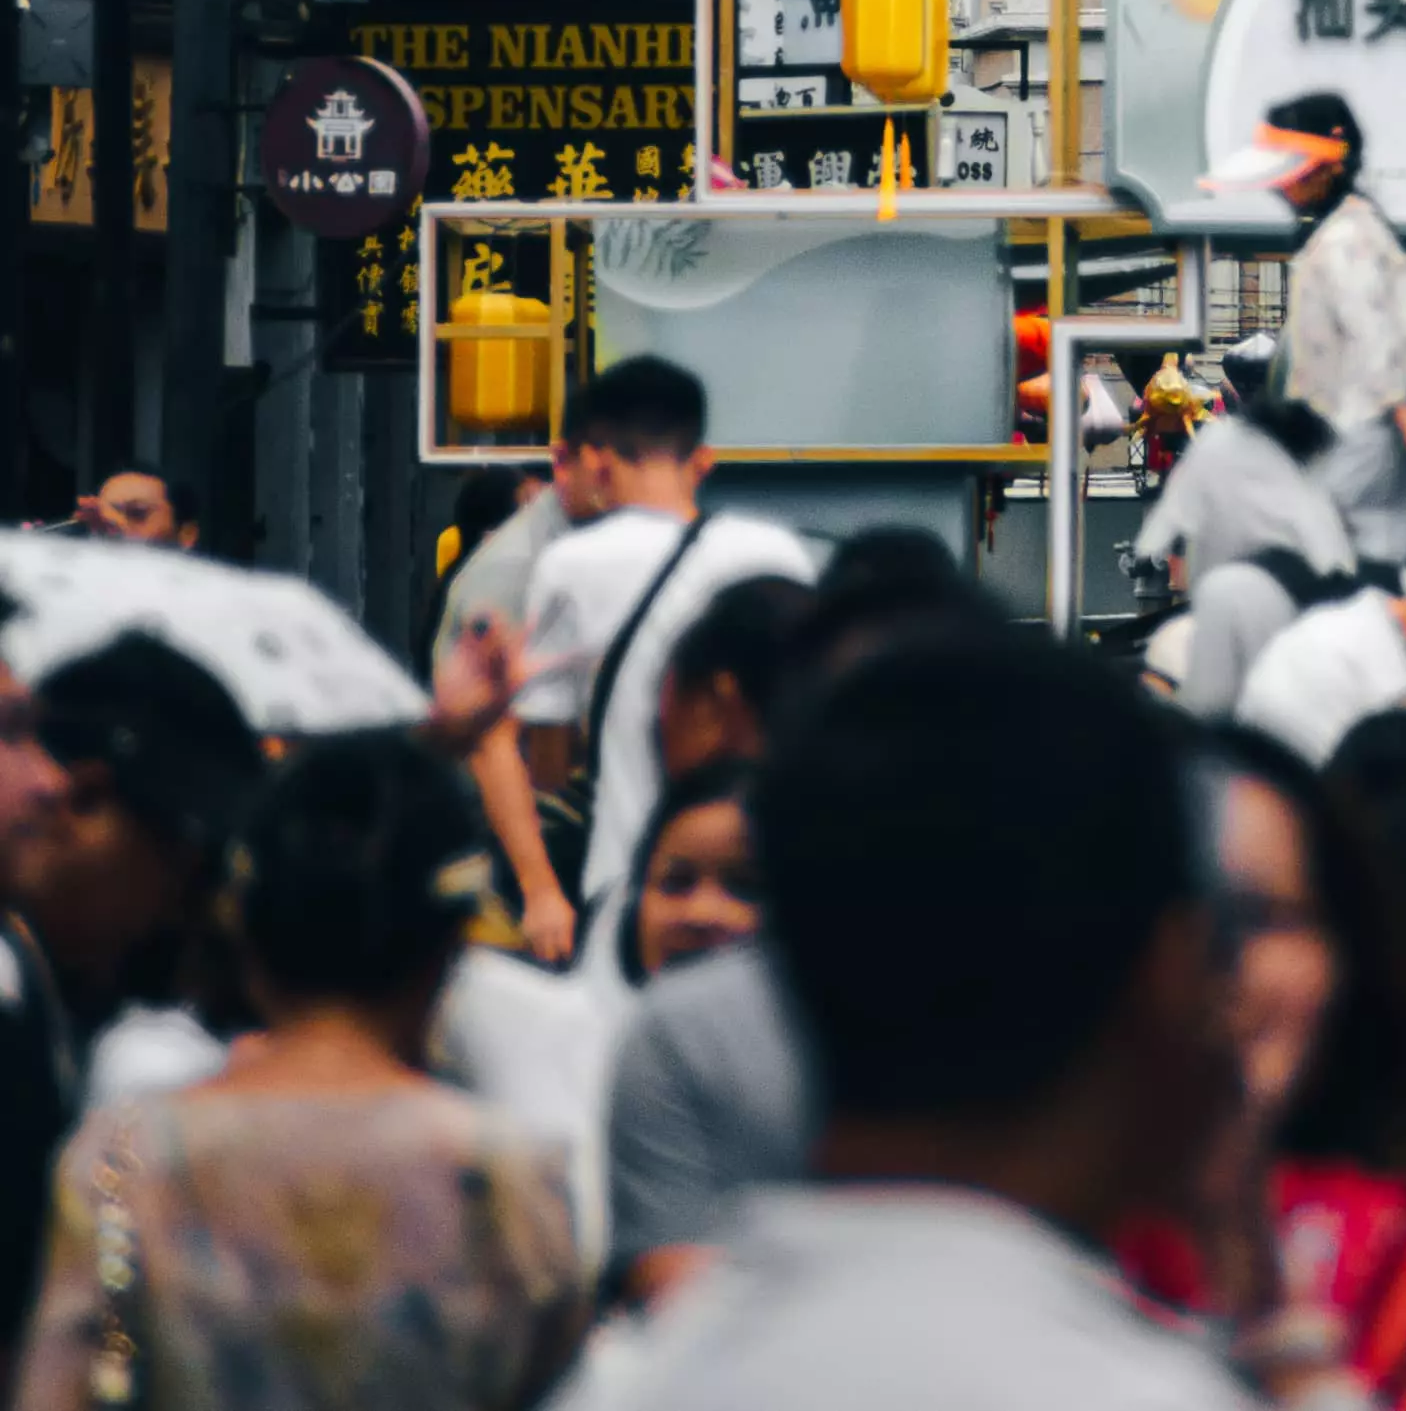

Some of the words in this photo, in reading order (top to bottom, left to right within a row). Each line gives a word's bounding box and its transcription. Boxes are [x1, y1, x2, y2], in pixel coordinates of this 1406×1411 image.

[350, 24, 470, 68] THE
[420, 84, 714, 131] SPENSAR
[956, 161, 994, 180] OSS
